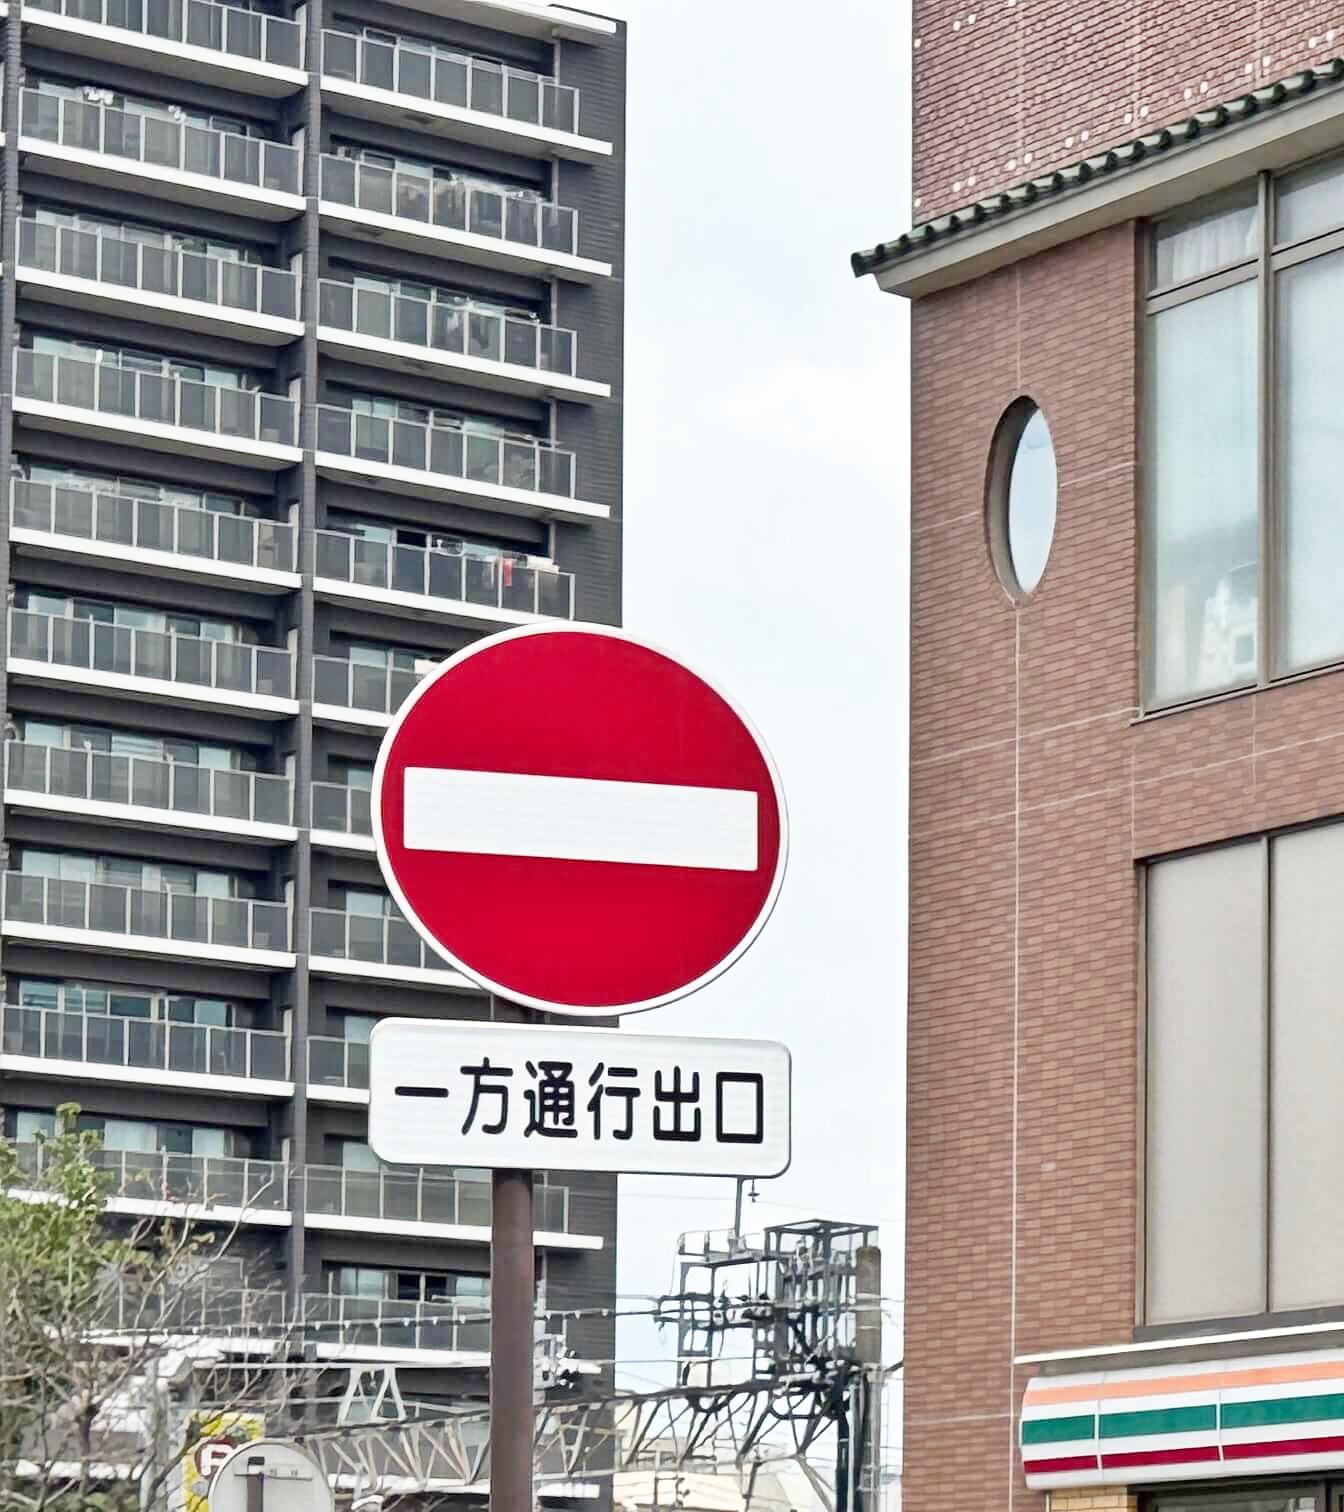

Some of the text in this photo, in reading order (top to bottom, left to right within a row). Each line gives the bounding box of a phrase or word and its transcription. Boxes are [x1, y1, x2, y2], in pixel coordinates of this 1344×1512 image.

[394, 1057, 764, 1145] 一方通行出口
